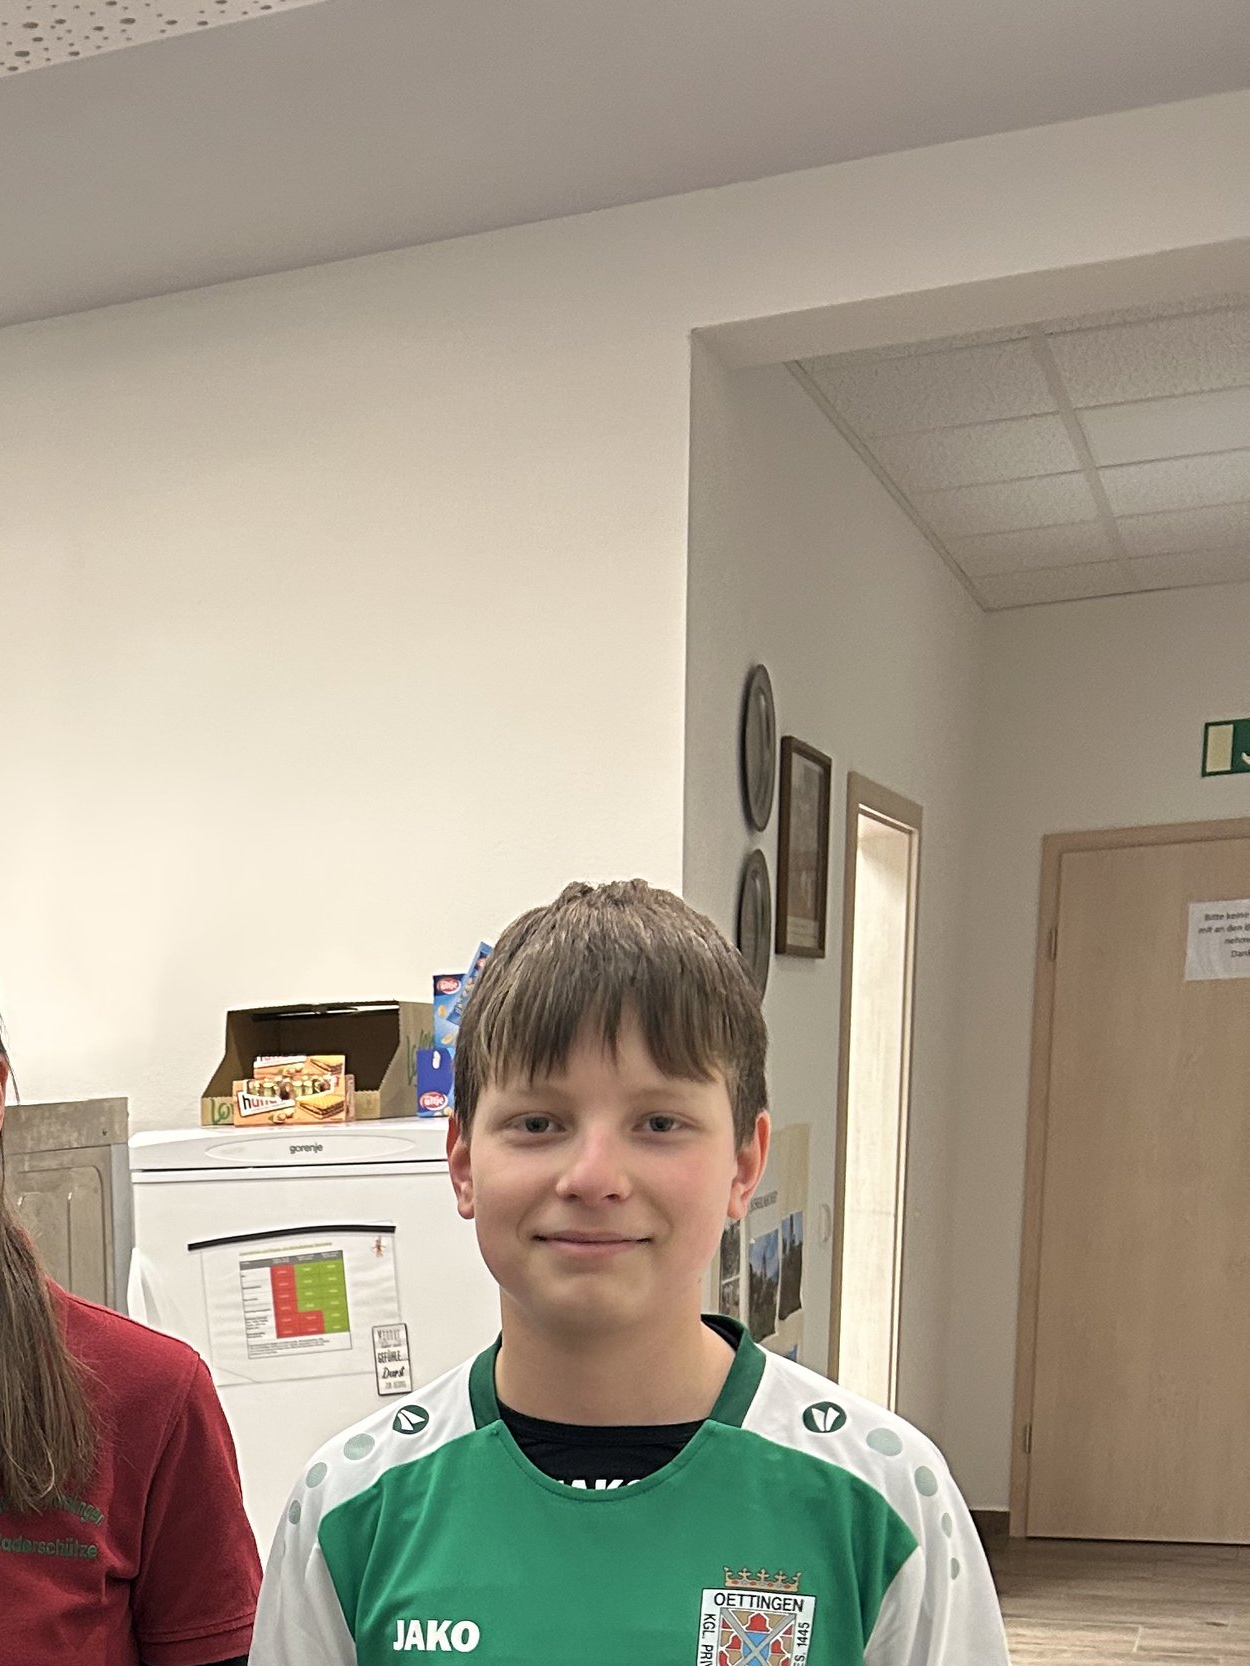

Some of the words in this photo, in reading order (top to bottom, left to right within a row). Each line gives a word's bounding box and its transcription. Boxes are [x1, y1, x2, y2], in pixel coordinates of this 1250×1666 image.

[289, 1142, 324, 1154] gorenje
[714, 1592, 805, 1613] OETTINGEN
[392, 1618, 481, 1653] JAKO
[797, 1622, 810, 1648] 1445
